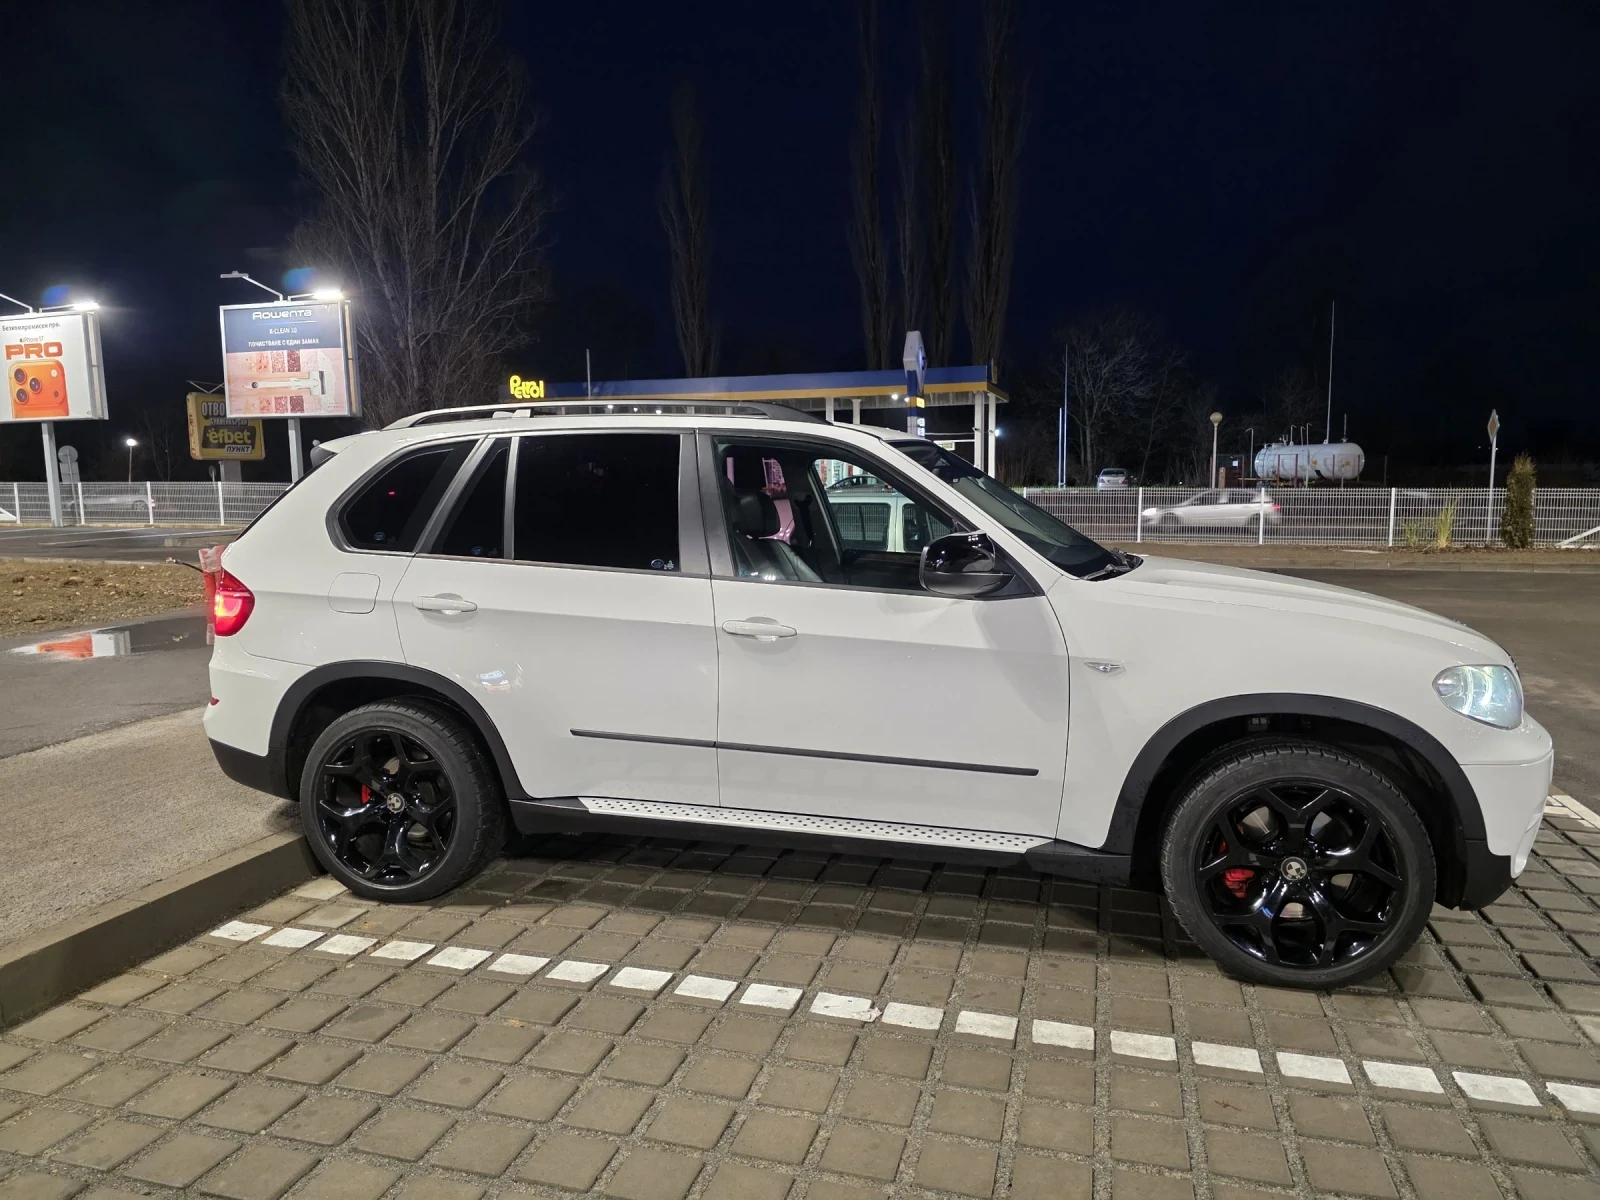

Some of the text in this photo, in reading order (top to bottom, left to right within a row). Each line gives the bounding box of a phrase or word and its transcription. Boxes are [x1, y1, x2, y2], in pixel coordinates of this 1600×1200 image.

[286, 338, 301, 346] ЕДИН
[5, 342, 63, 360] PRO
[509, 374, 545, 399] Petrol
[201, 401, 225, 416] ОТВО
[208, 429, 252, 444] efbet
[226, 445, 251, 453] ПУНКТ
